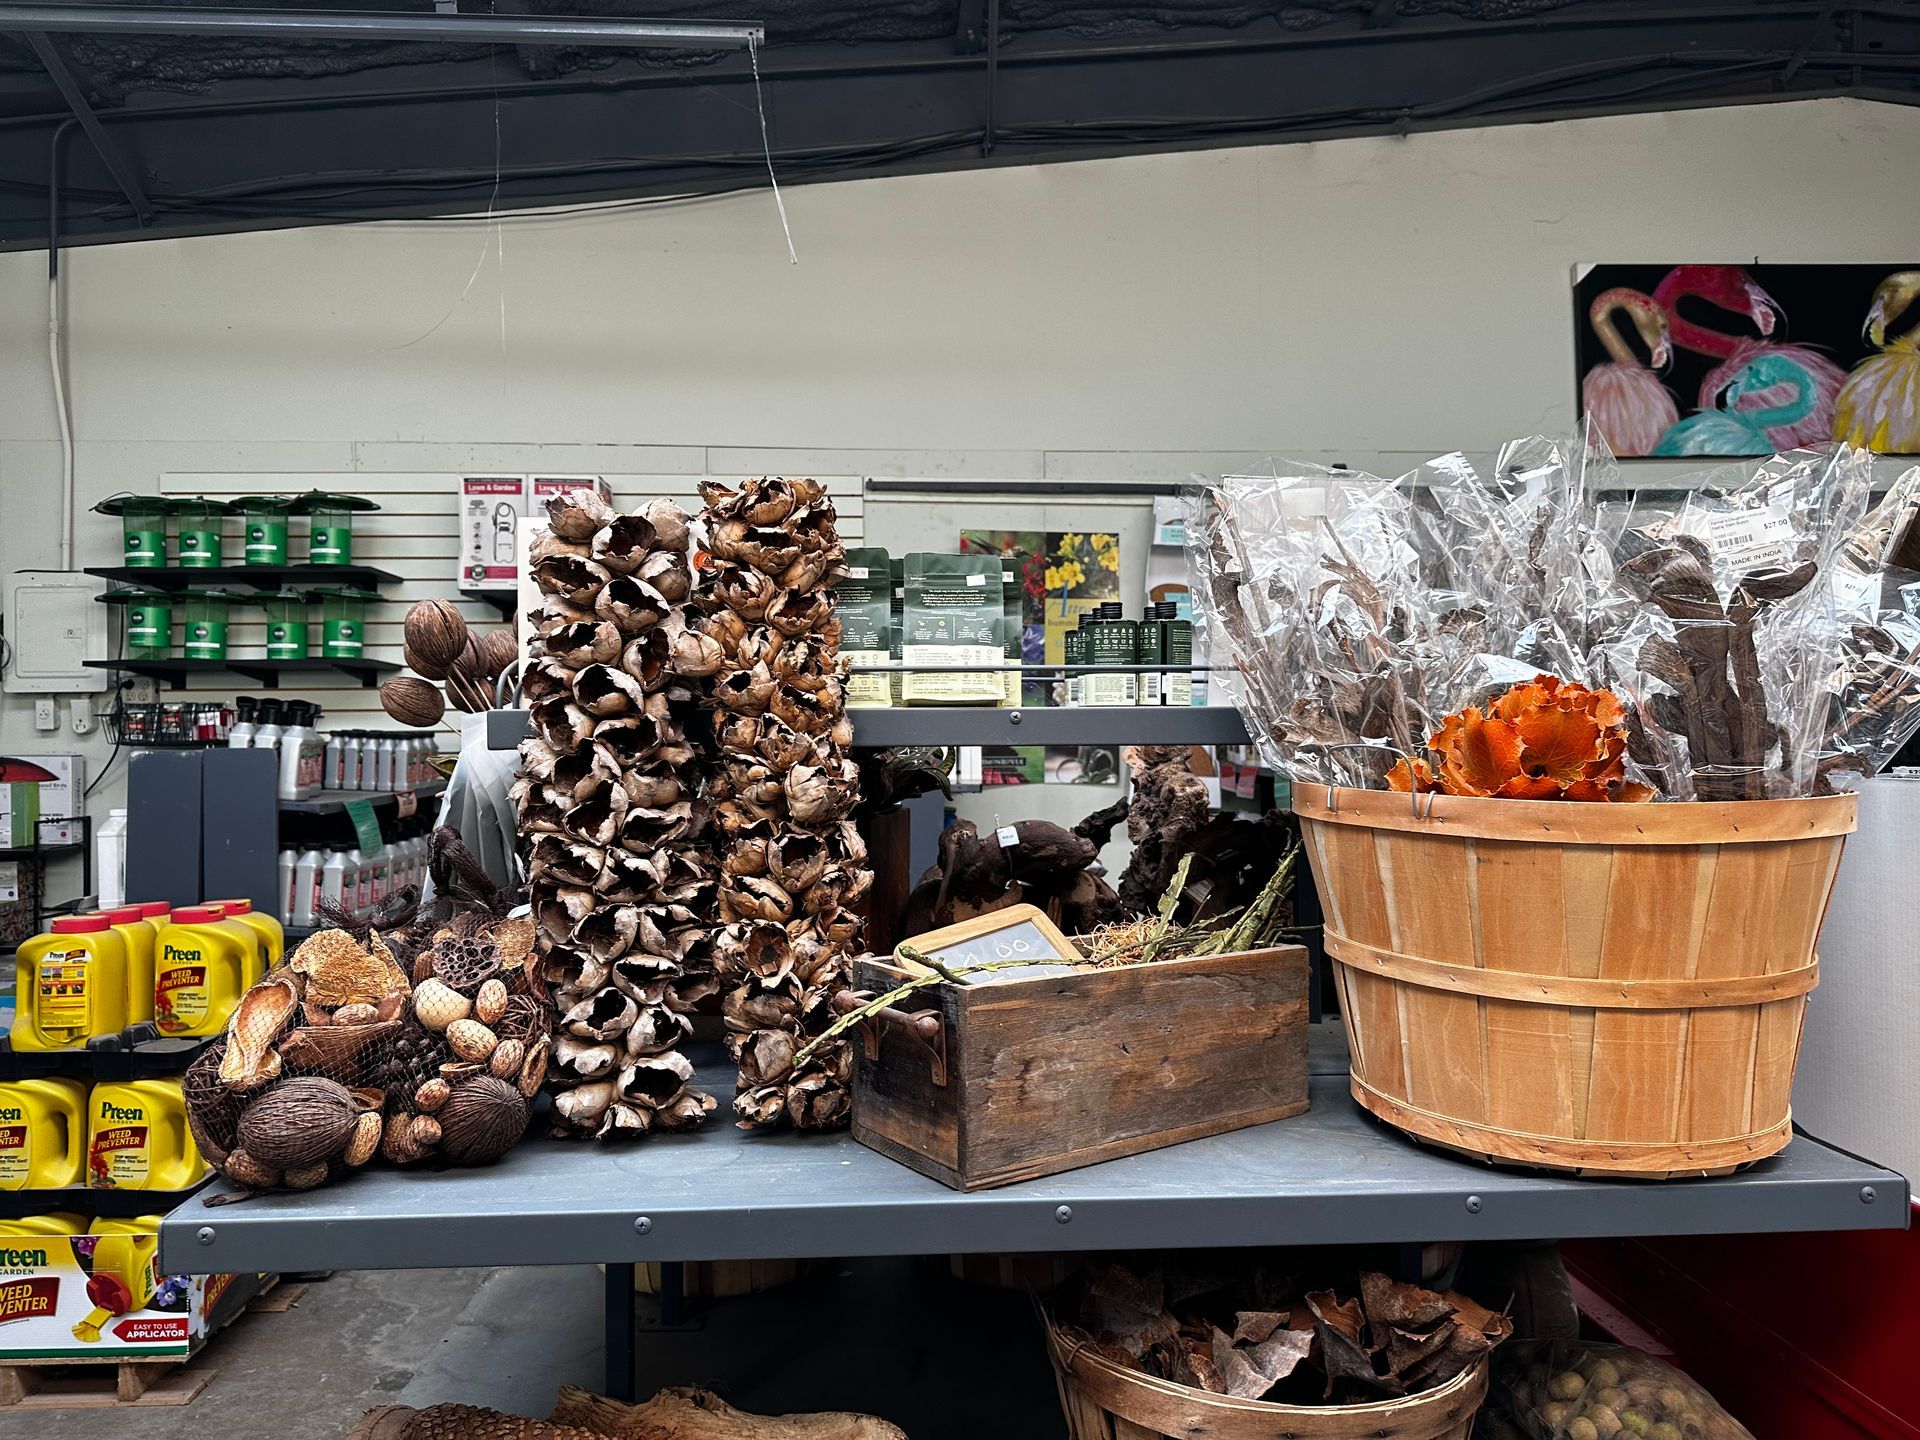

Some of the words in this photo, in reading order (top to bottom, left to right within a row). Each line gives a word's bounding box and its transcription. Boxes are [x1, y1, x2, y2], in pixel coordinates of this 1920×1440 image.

[1731, 555, 1752, 566] MADE
[1763, 548, 1782, 558] INDIA
[163, 944, 202, 961] Preen
[171, 969, 192, 979] WEED
[161, 975, 200, 989] PREVENTER
[100, 1101, 144, 1120] Preen
[108, 1129, 132, 1140] WEED
[97, 1136, 141, 1150] PREVENTER
[126, 1329, 185, 1339] APPLICATOR
